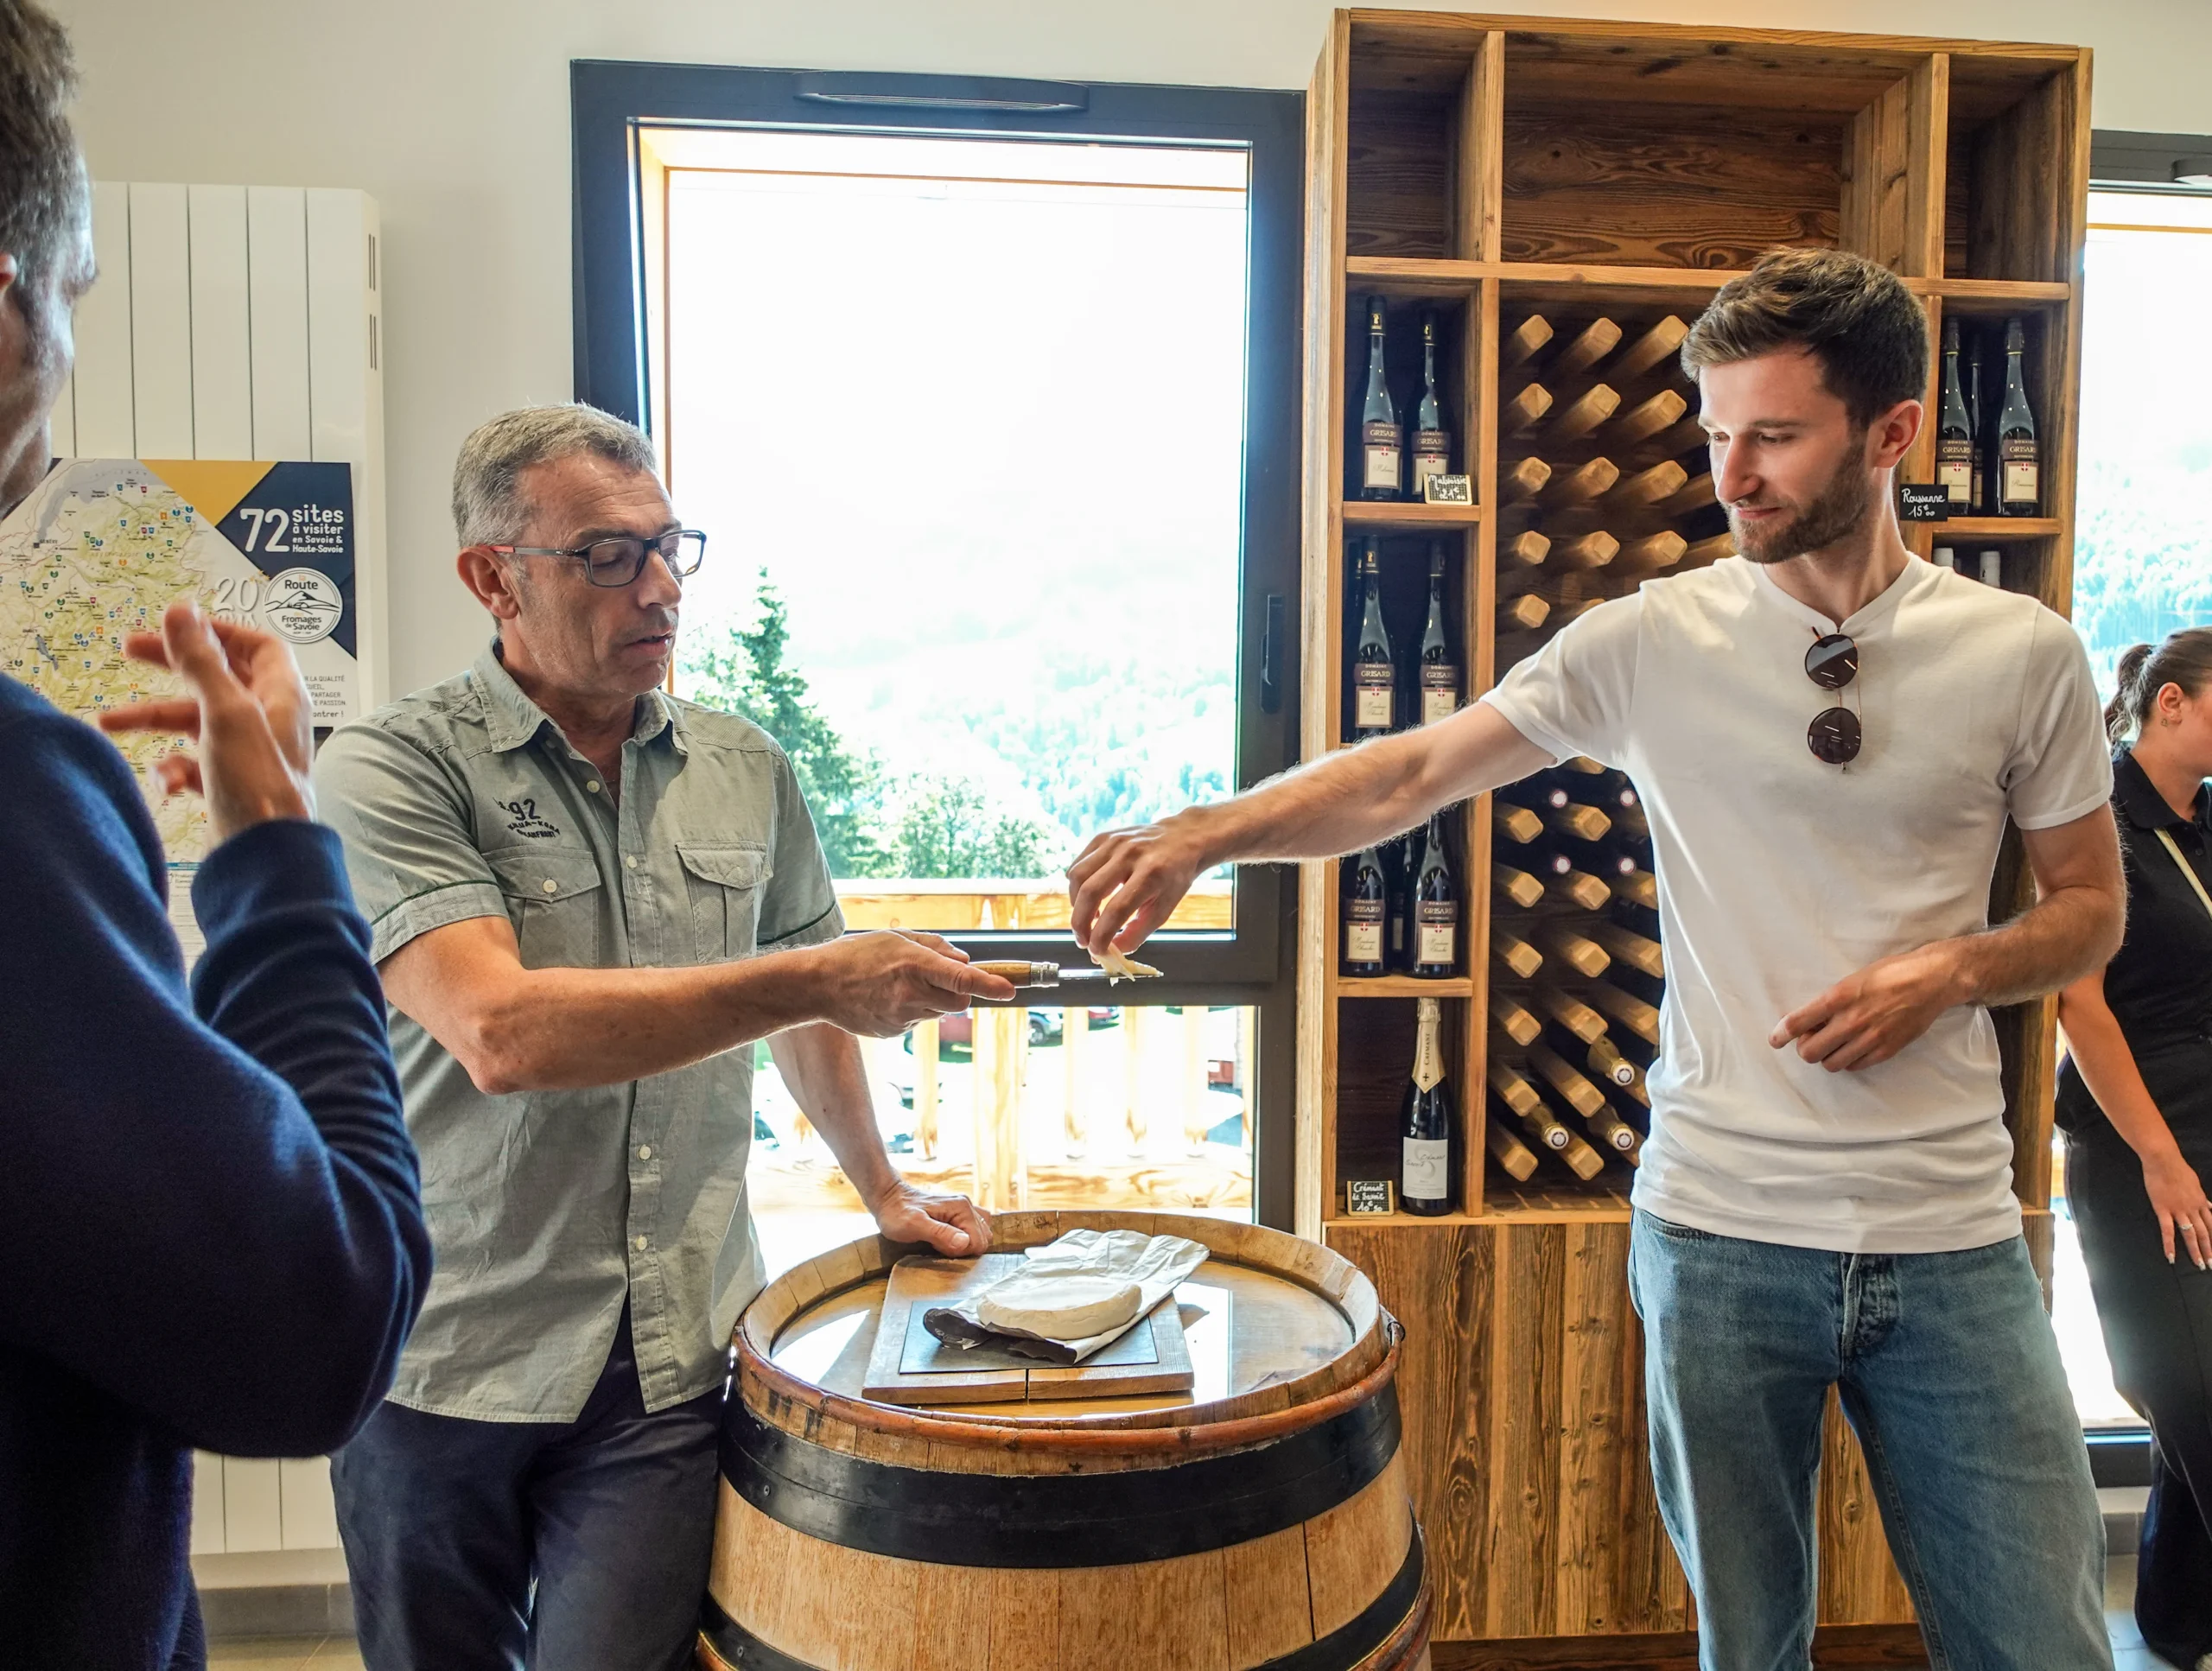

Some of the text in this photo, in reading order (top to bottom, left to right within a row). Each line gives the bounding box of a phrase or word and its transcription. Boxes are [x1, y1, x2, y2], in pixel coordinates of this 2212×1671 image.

[1901, 487, 1945, 503] Roussanne
[292, 504, 344, 523] sites
[239, 508, 290, 553] 72
[292, 523, 343, 534] à visiter
[305, 535, 334, 543] Savoie
[292, 544, 344, 553] Haute-Savoie
[284, 580, 318, 590] Route
[215, 576, 259, 613] 20
[282, 615, 322, 625] Fromages
[293, 622, 321, 631] Savoie
[508, 798, 541, 821] 92
